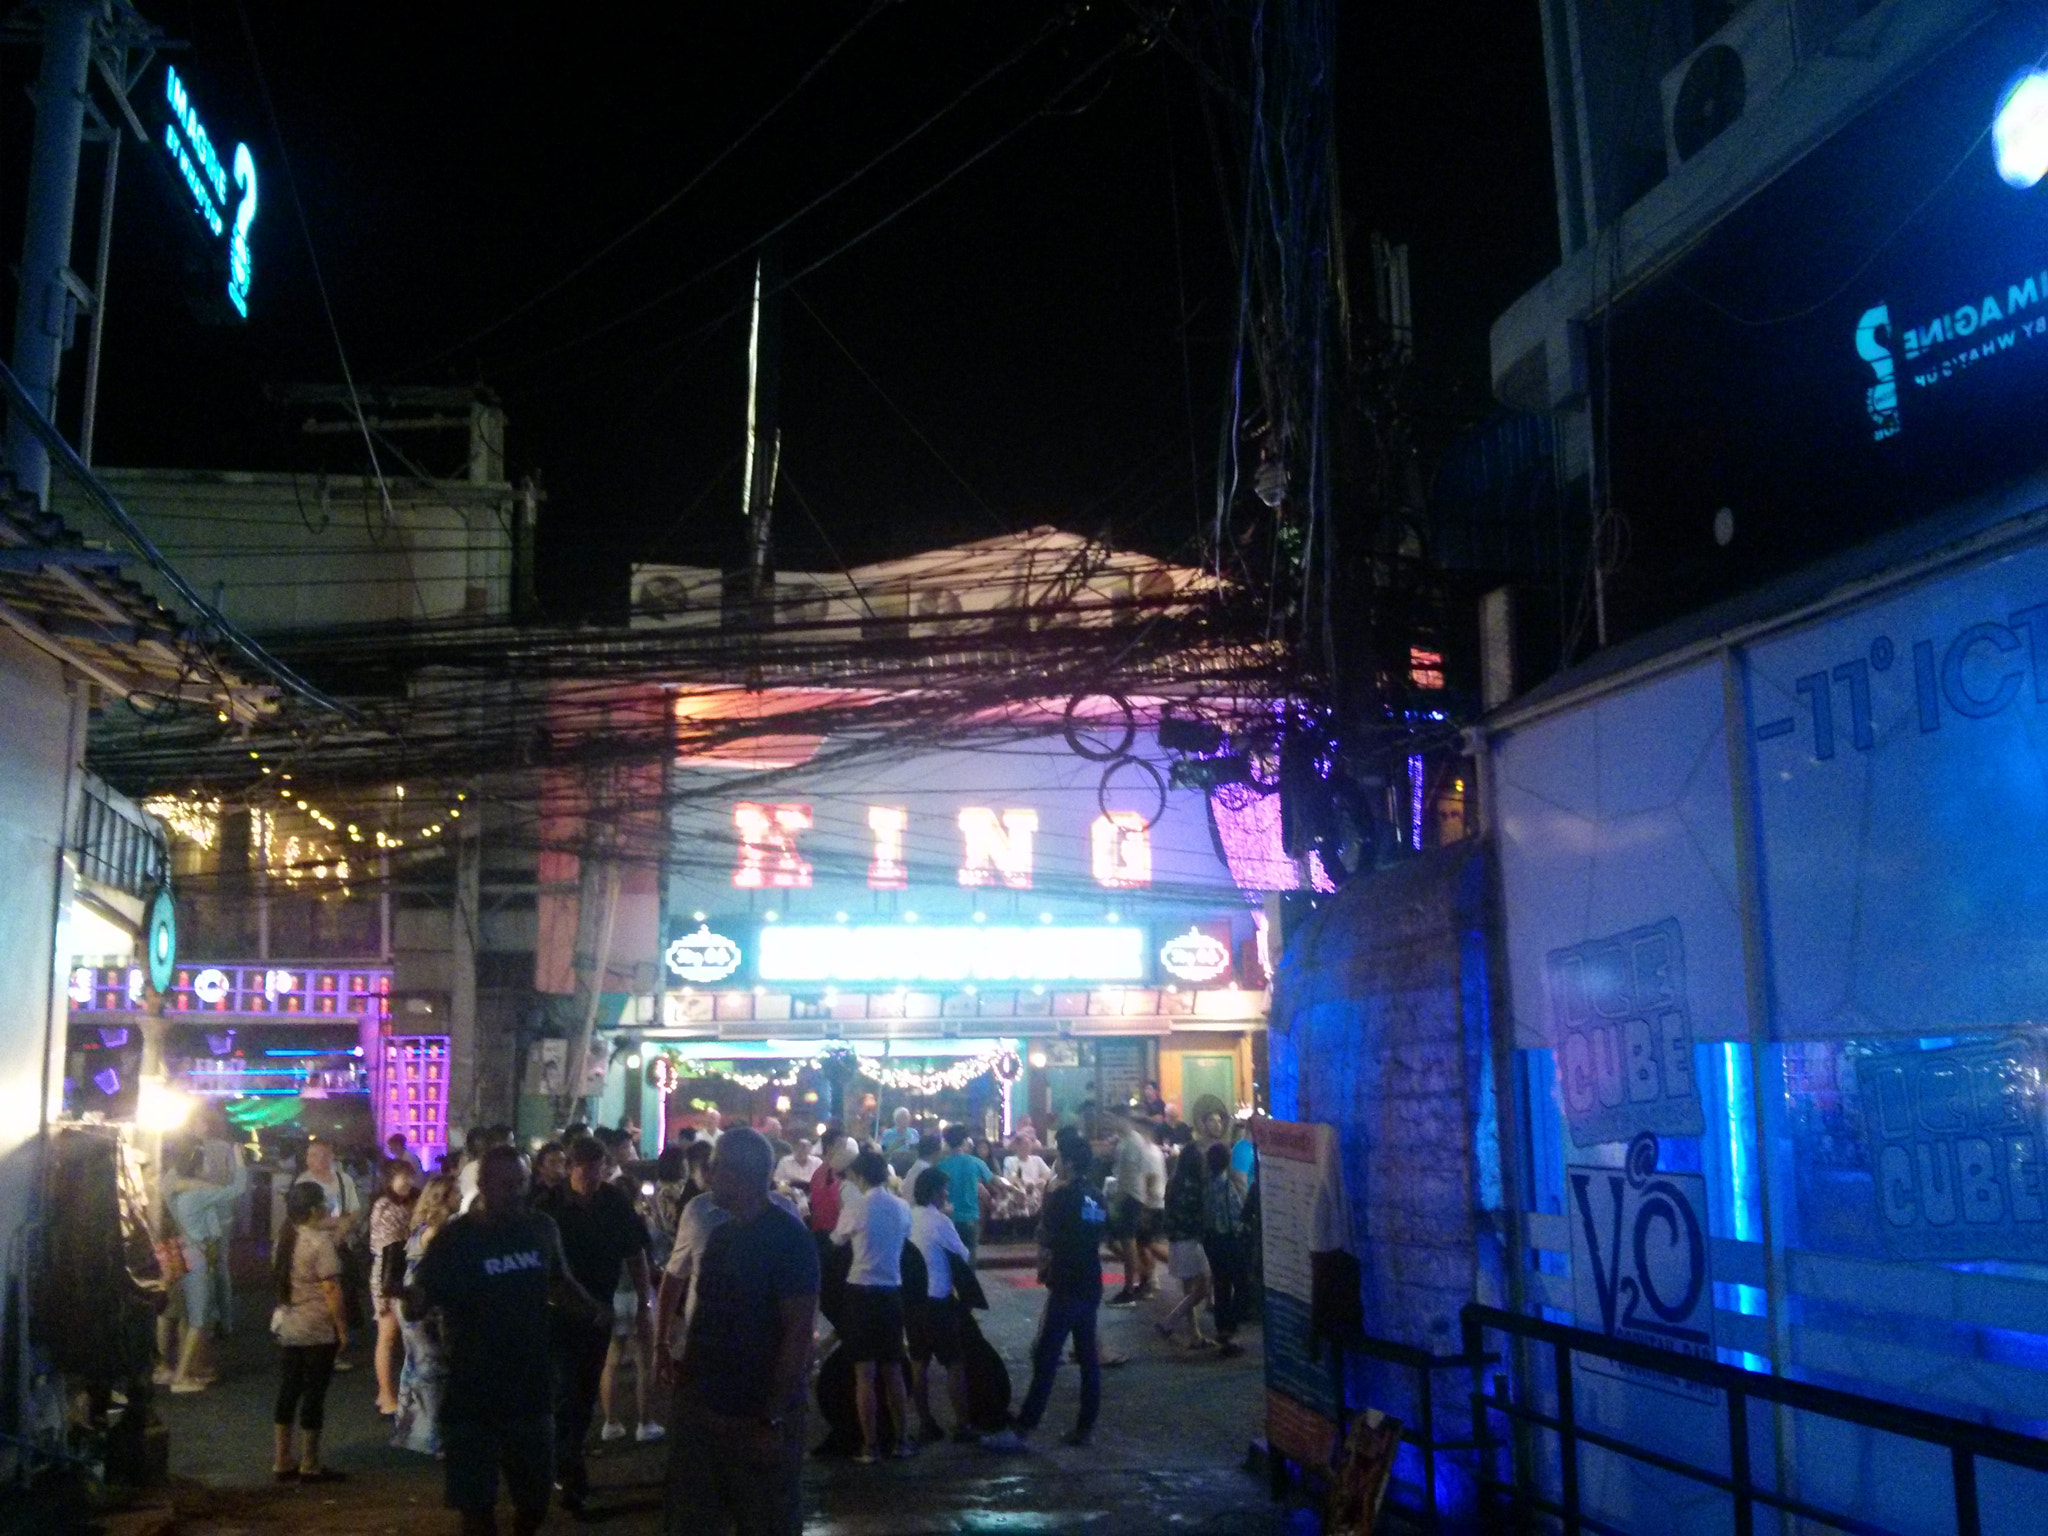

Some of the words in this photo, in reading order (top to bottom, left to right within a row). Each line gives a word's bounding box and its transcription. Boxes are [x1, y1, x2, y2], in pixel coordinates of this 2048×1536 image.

[731, 801, 1153, 890] KING
[1564, 1009, 1694, 1112] CUBE
[1878, 1131, 2046, 1228] CUBE
[483, 1250, 543, 1276] RAW
